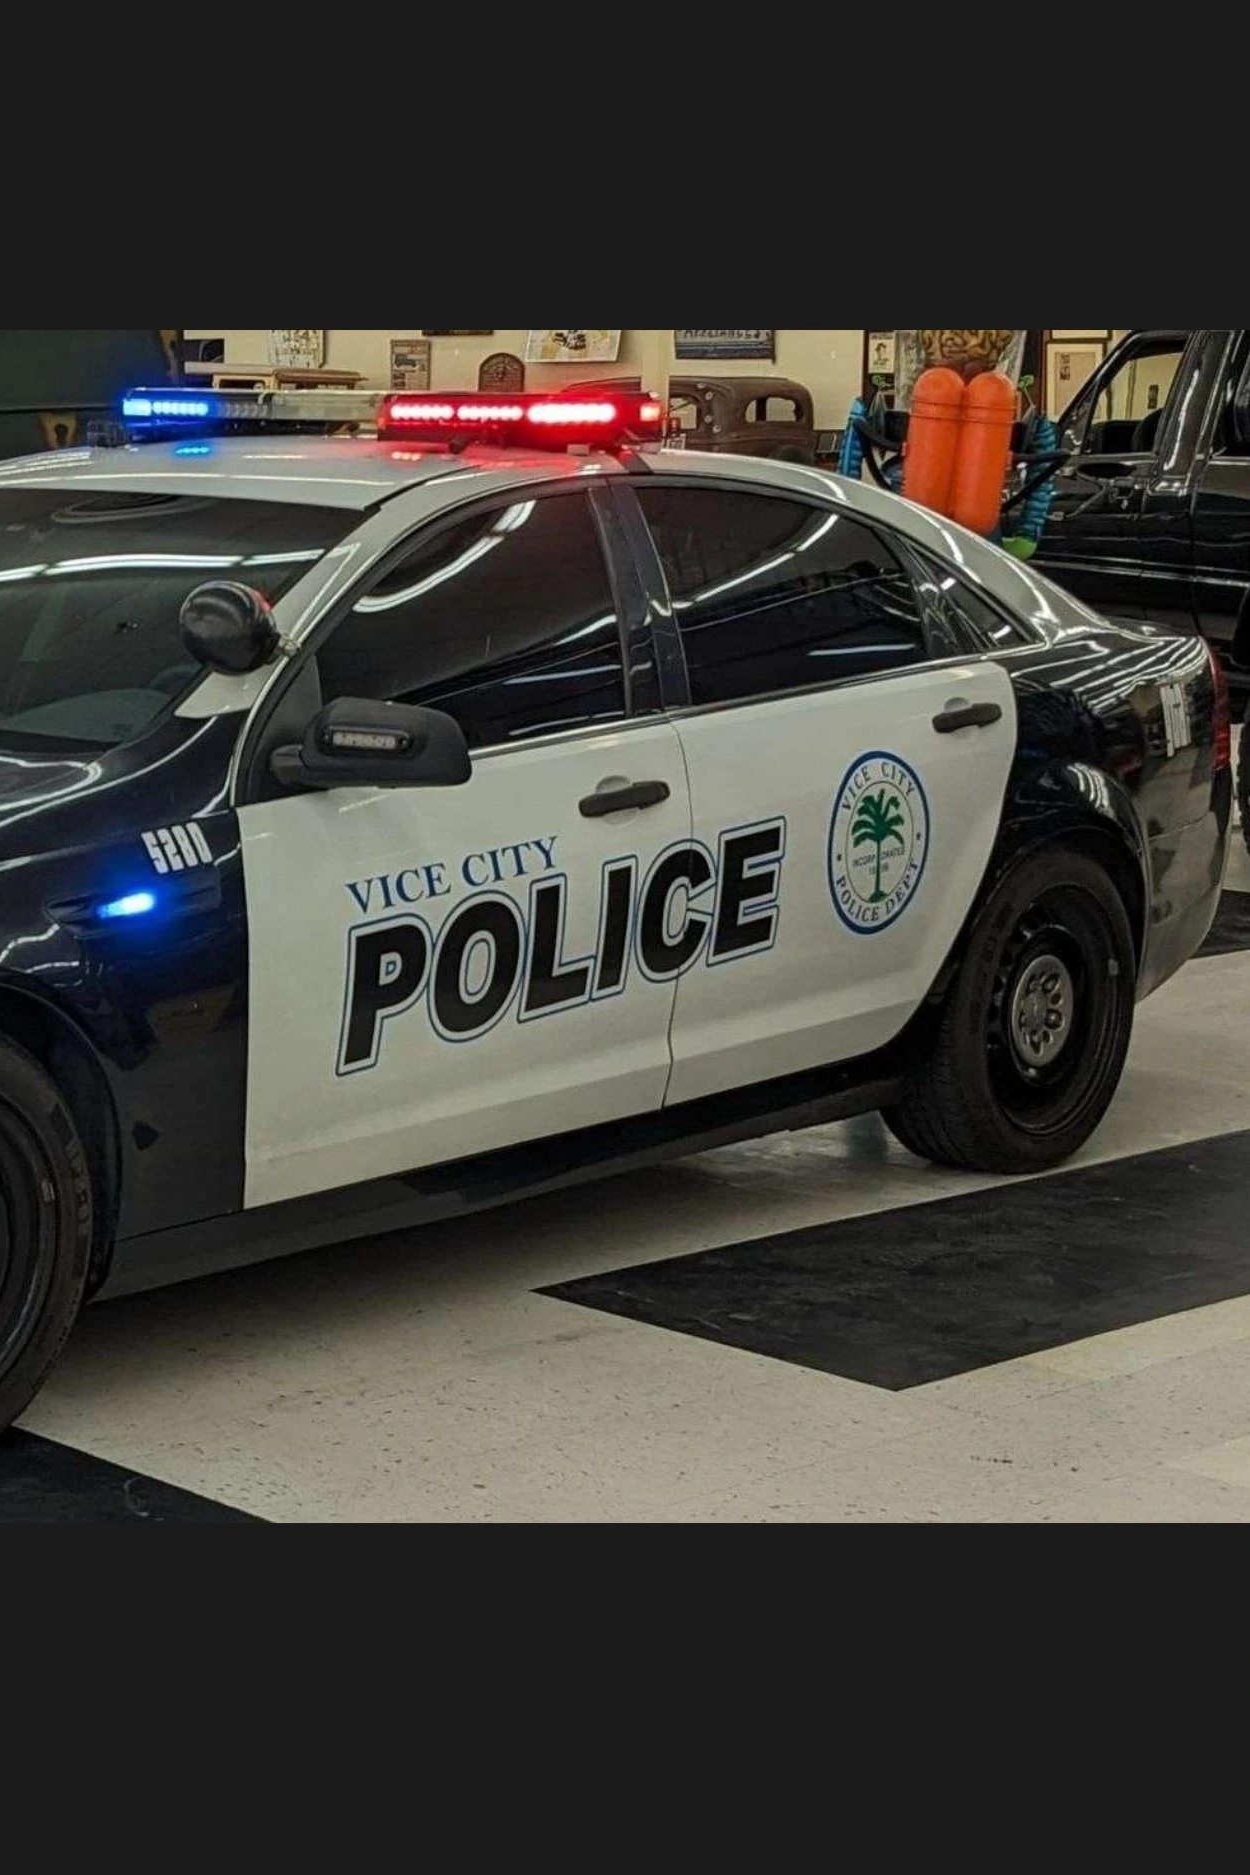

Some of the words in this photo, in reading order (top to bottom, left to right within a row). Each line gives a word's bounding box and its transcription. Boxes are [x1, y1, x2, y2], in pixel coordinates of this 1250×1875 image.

[841, 765, 872, 811] VICE
[881, 761, 916, 797] CITY
[141, 821, 213, 874] 5280
[345, 863, 451, 915] VICE
[461, 836, 558, 888] CITY
[835, 875, 880, 923] POLICE
[335, 816, 787, 1077] POLICE
